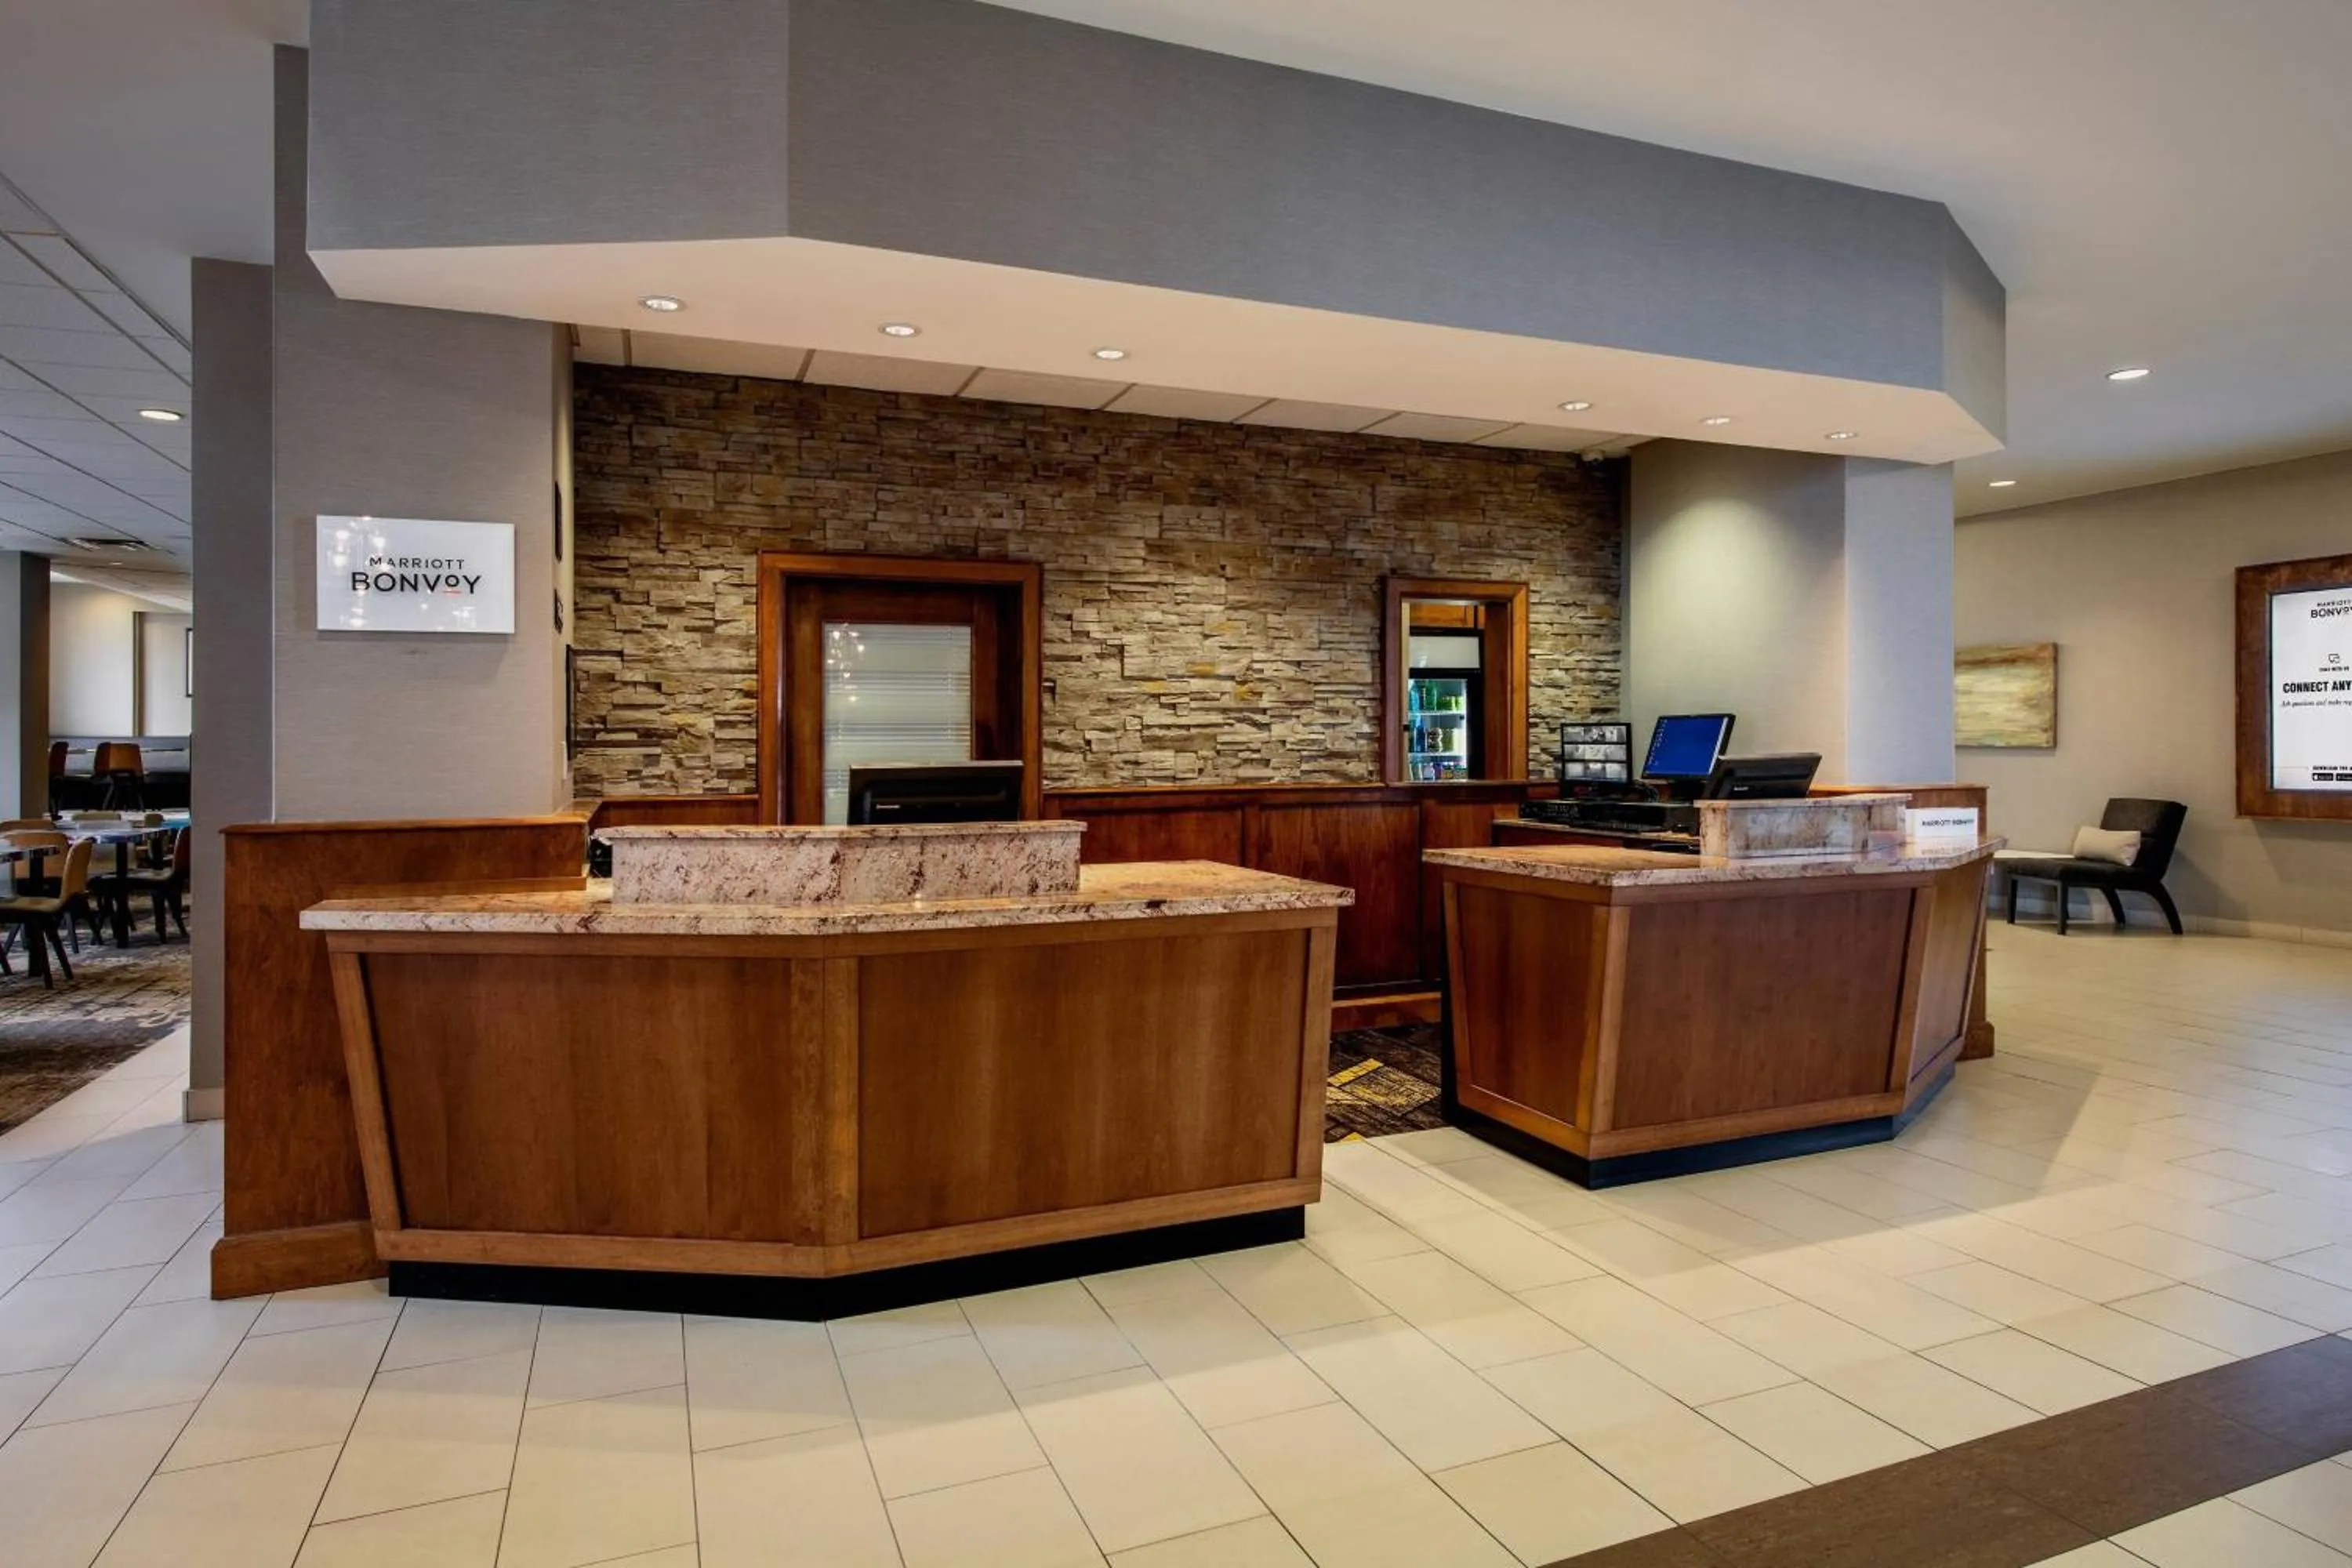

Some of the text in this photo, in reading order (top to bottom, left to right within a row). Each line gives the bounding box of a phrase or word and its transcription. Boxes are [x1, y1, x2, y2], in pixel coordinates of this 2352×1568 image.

[369, 557, 465, 569] MARRIOTT
[351, 572, 481, 594] BONVOY
[2283, 680, 2352, 694] CONNECT ANY
